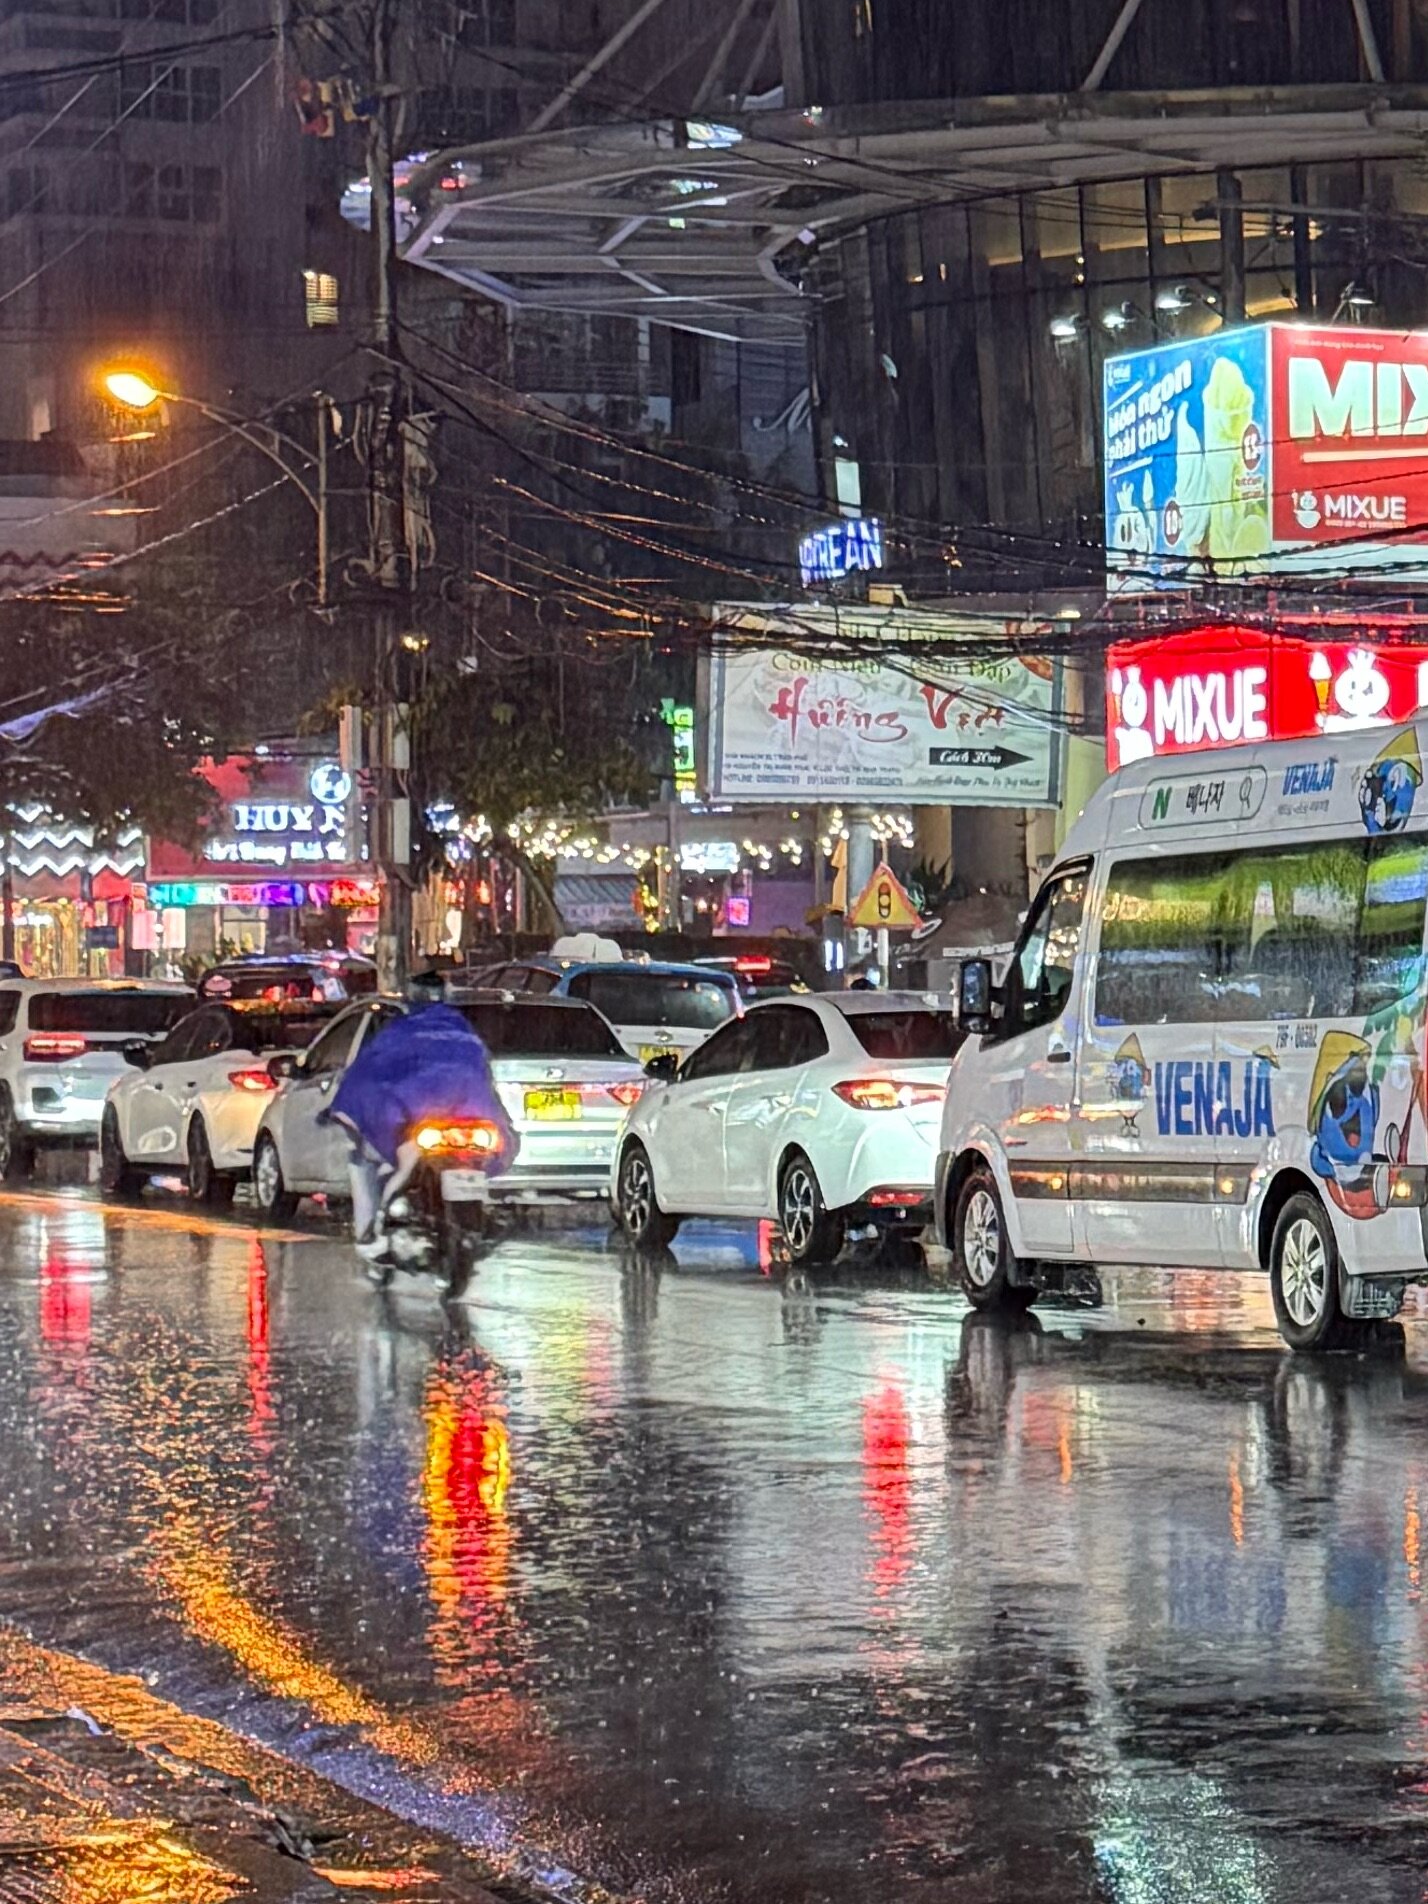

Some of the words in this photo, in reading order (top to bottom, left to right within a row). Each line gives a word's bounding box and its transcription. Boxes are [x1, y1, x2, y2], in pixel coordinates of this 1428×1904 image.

[1324, 493, 1407, 521] MIXUE
[1154, 665, 1268, 745] MIXUE
[1282, 760, 1337, 797] VENAJA
[1151, 787, 1172, 821] N
[1155, 1059, 1277, 1138] VENAJA
